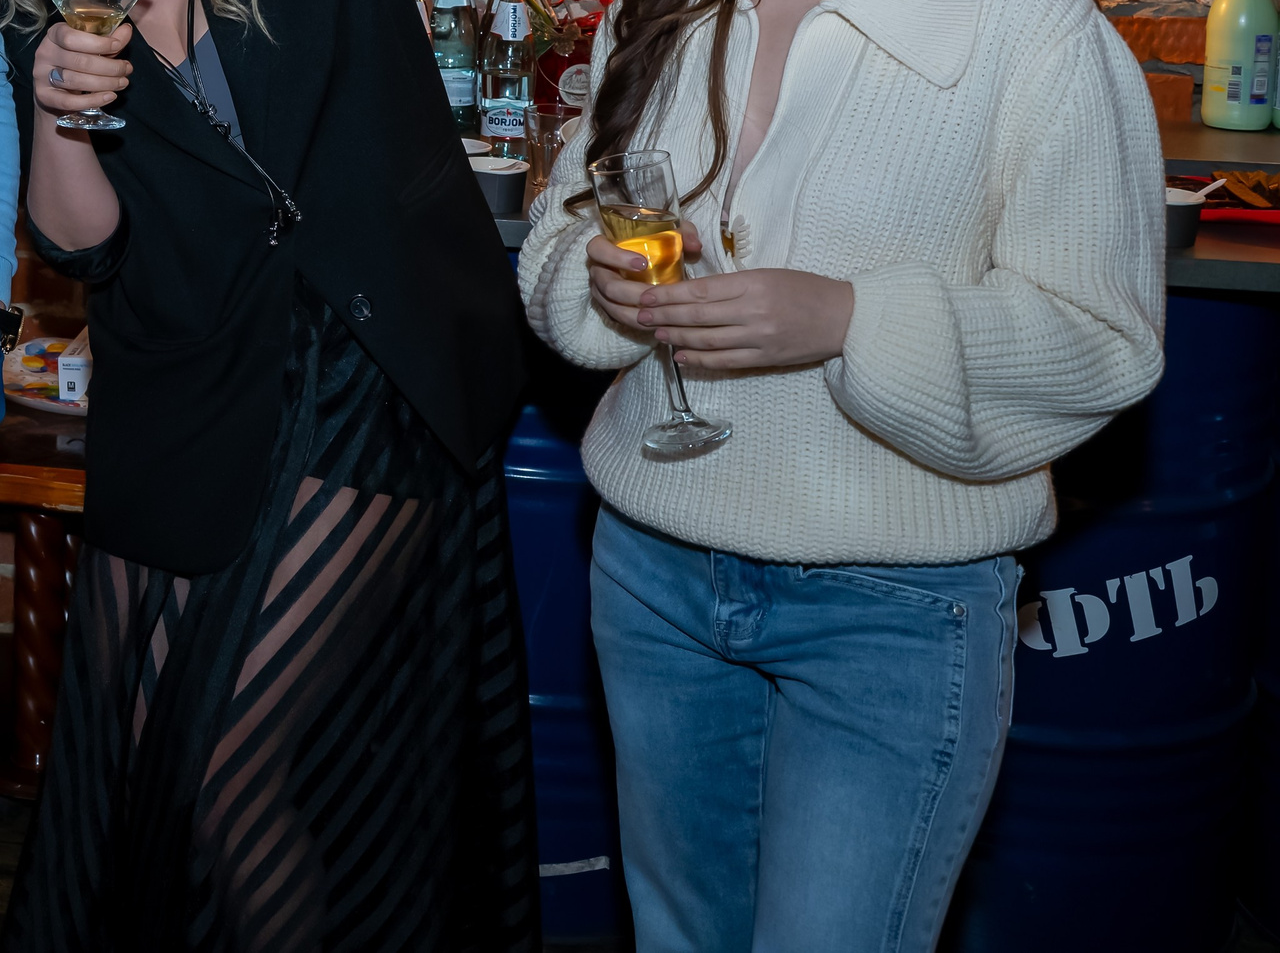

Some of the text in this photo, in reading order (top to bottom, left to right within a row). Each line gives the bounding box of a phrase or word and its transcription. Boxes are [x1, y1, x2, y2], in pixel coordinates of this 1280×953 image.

[510, 5, 518, 38] BORJOMI
[488, 116, 525, 127] BORJOM
[1017, 554, 1219, 658] ФТЬ
